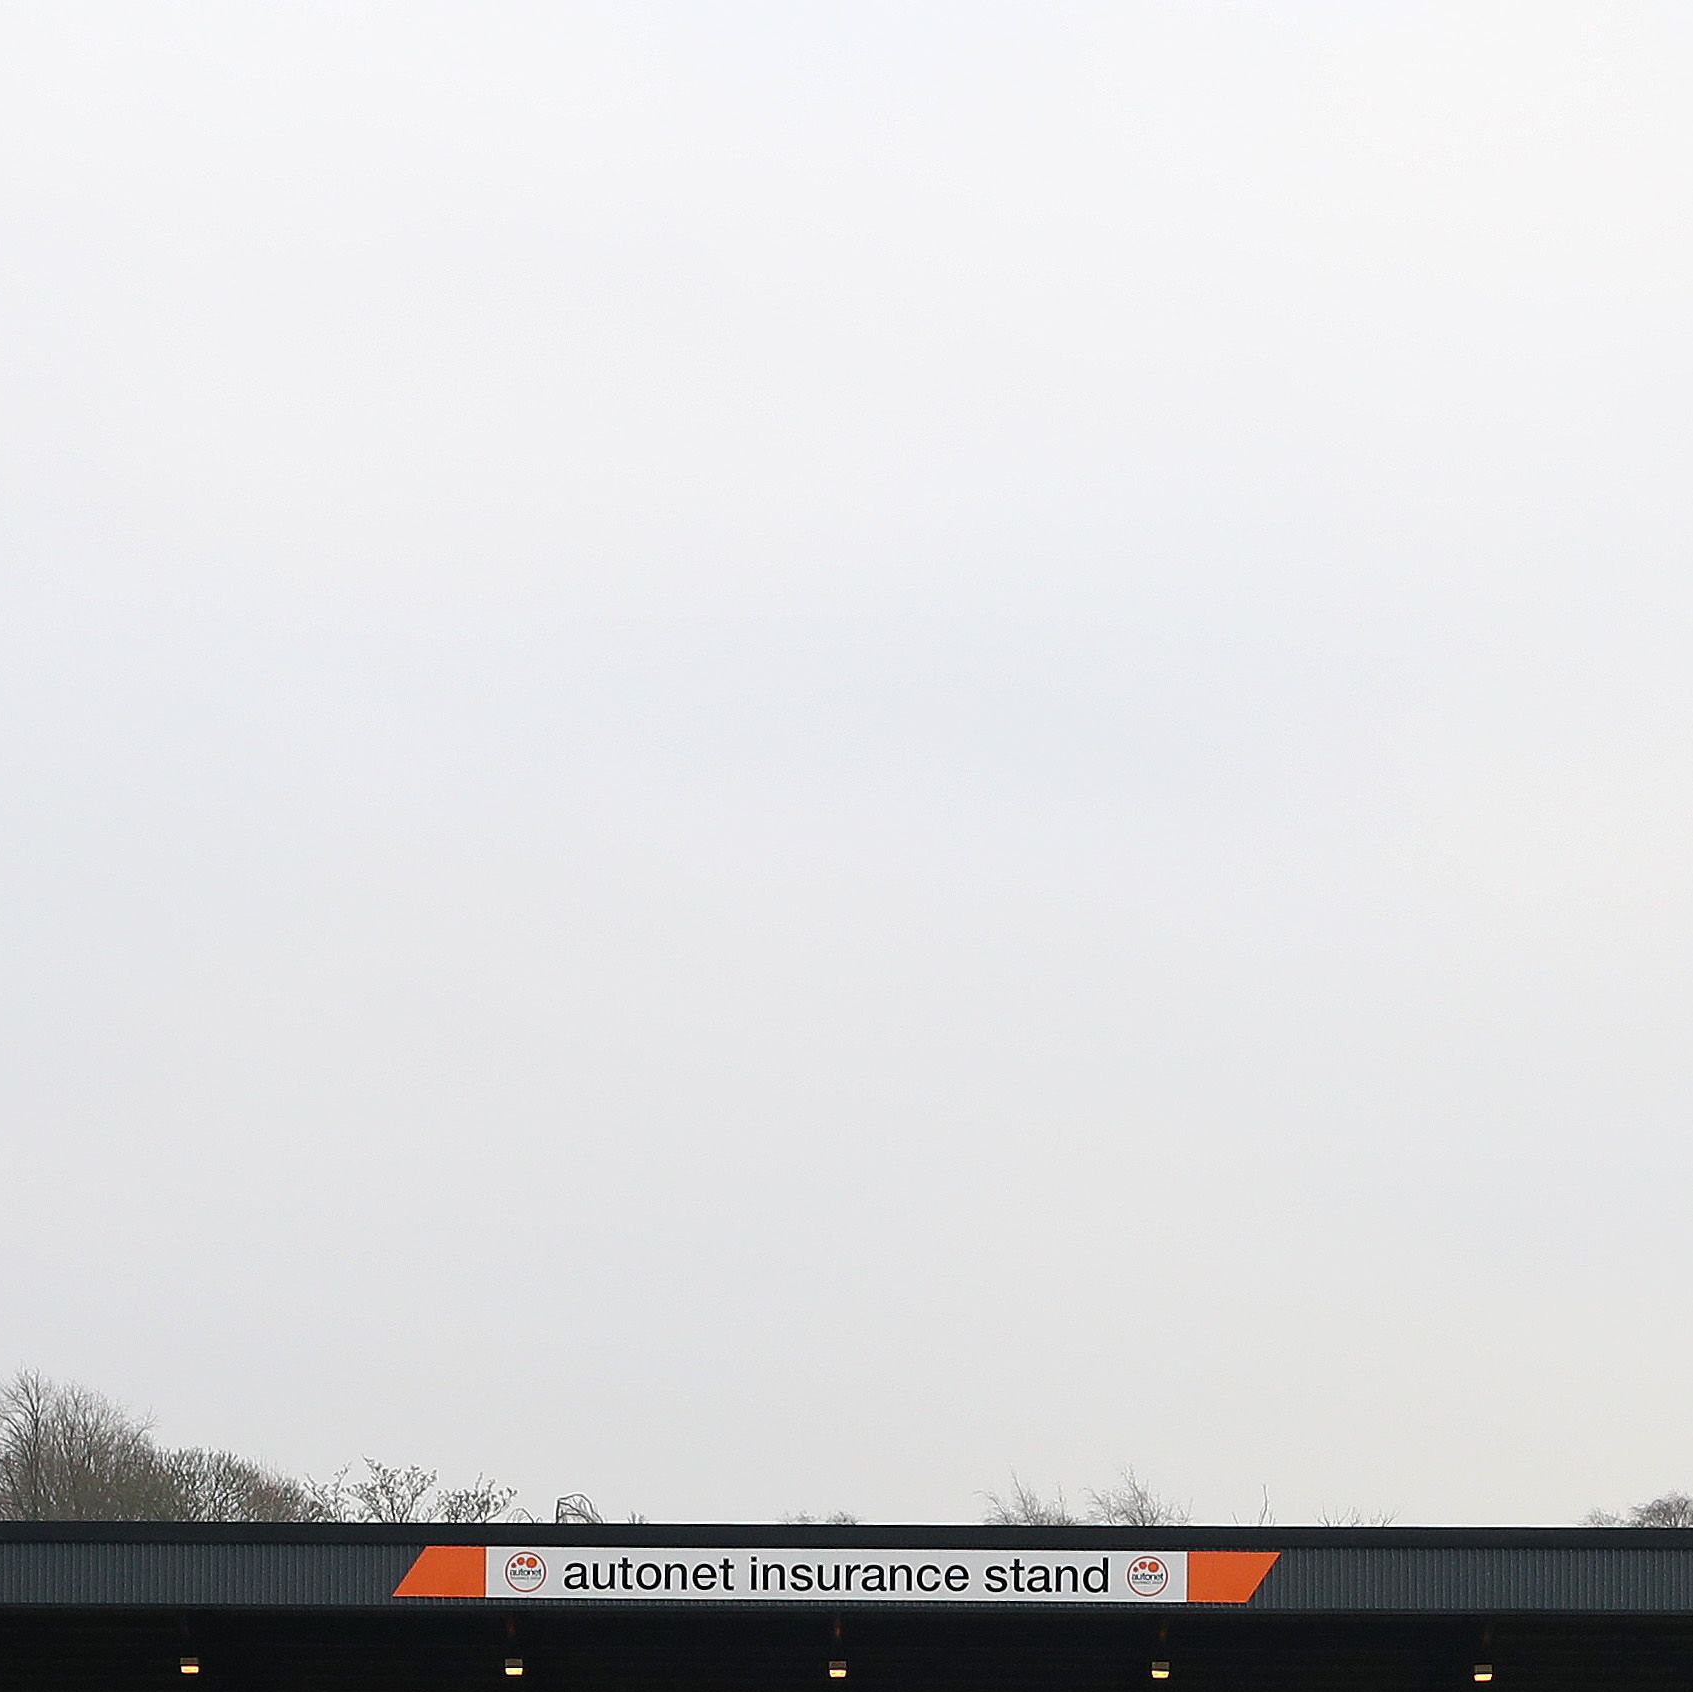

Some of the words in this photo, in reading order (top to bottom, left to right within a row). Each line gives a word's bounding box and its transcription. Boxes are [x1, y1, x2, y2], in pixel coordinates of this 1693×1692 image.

[563, 1556, 735, 1591] autonet
[750, 1556, 970, 1592] insurance
[984, 1557, 1109, 1593] stand
